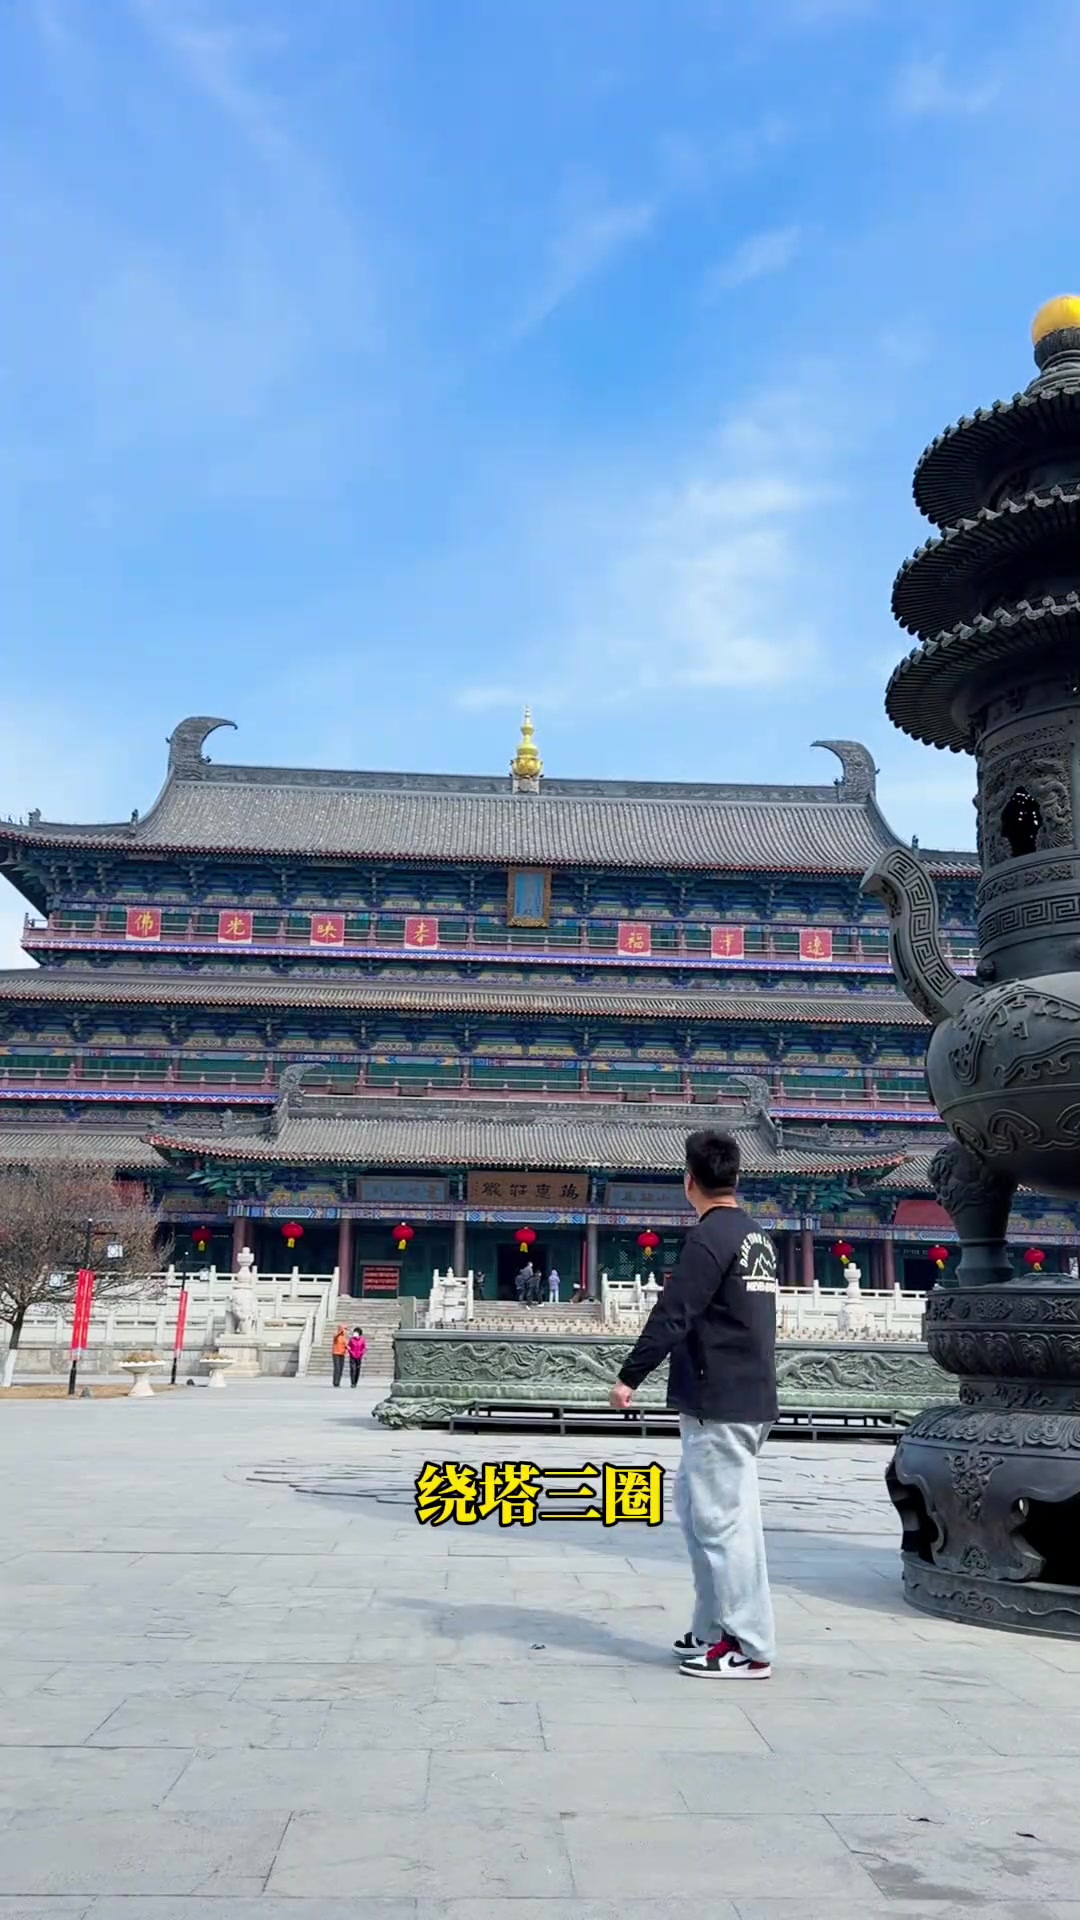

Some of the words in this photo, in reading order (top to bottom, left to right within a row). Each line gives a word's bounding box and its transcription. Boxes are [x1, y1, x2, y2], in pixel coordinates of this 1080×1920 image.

[135, 911, 153, 937] 佛
[226, 916, 245, 937] 光
[317, 920, 337, 939] 映
[624, 932, 645, 949] 福
